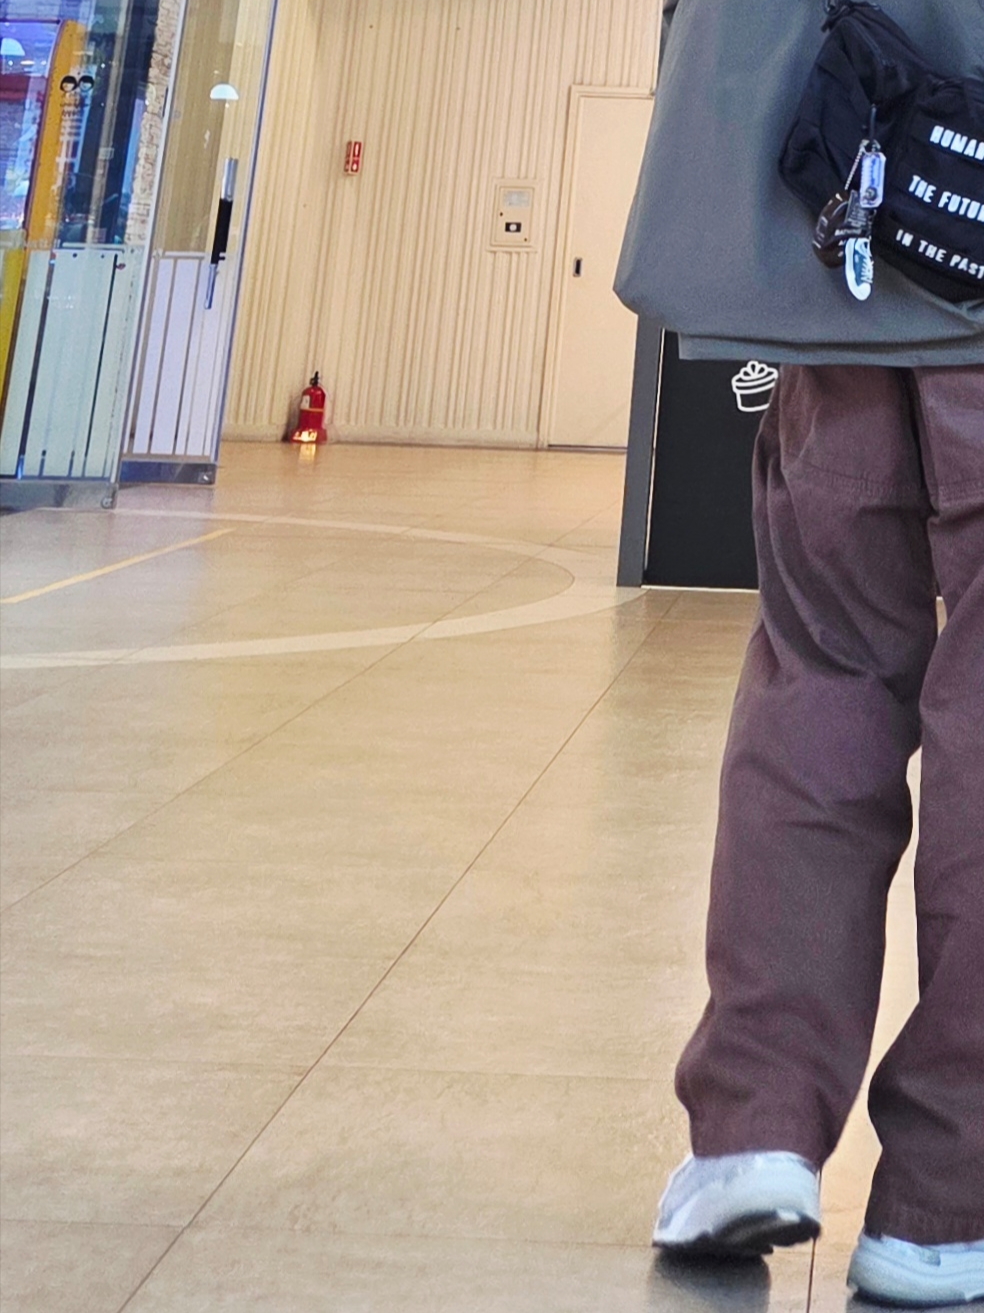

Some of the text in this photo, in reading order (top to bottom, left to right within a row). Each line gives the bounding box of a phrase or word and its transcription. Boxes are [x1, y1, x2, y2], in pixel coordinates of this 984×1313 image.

[908, 174, 937, 204] THE
[896, 228, 914, 247] IN
[918, 239, 947, 263] THE
